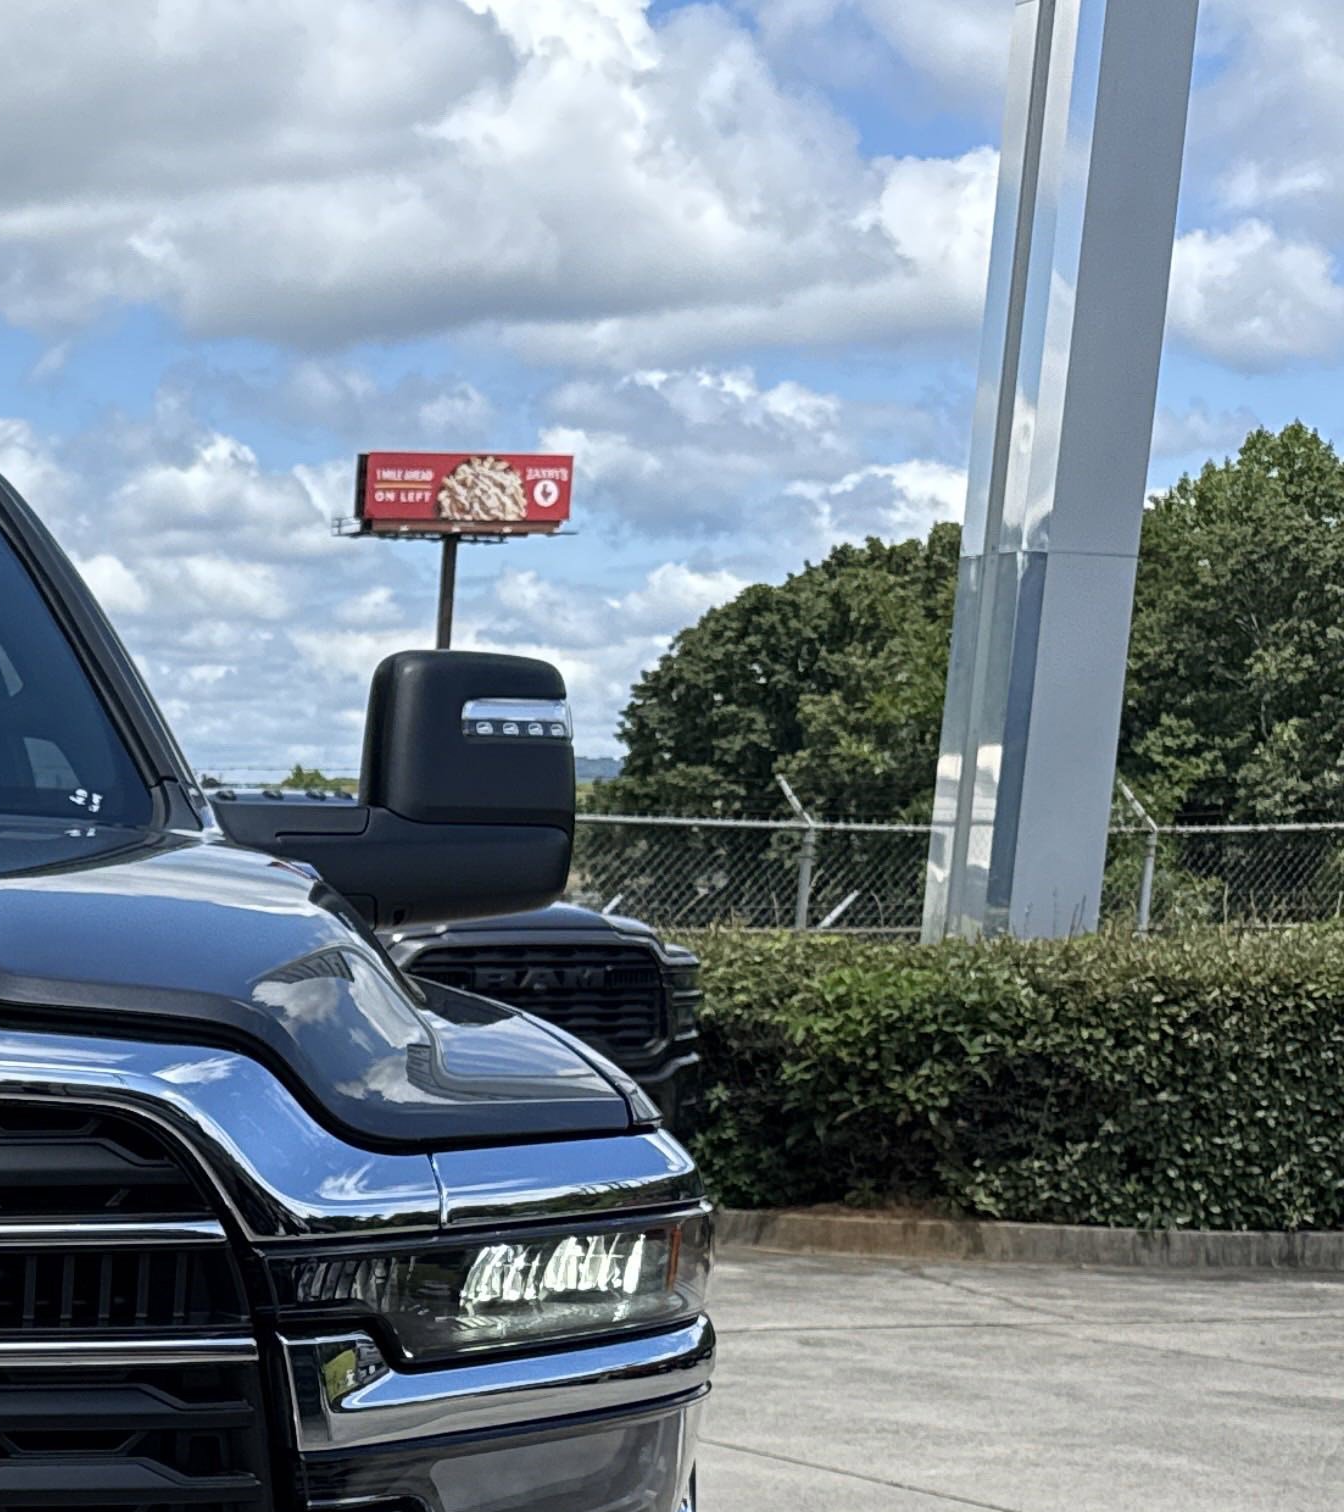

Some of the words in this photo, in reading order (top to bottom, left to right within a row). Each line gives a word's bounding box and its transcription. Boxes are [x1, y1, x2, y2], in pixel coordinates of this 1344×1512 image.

[374, 491, 396, 502] ON
[400, 491, 432, 503] LEFT
[475, 966, 605, 989] RAM
